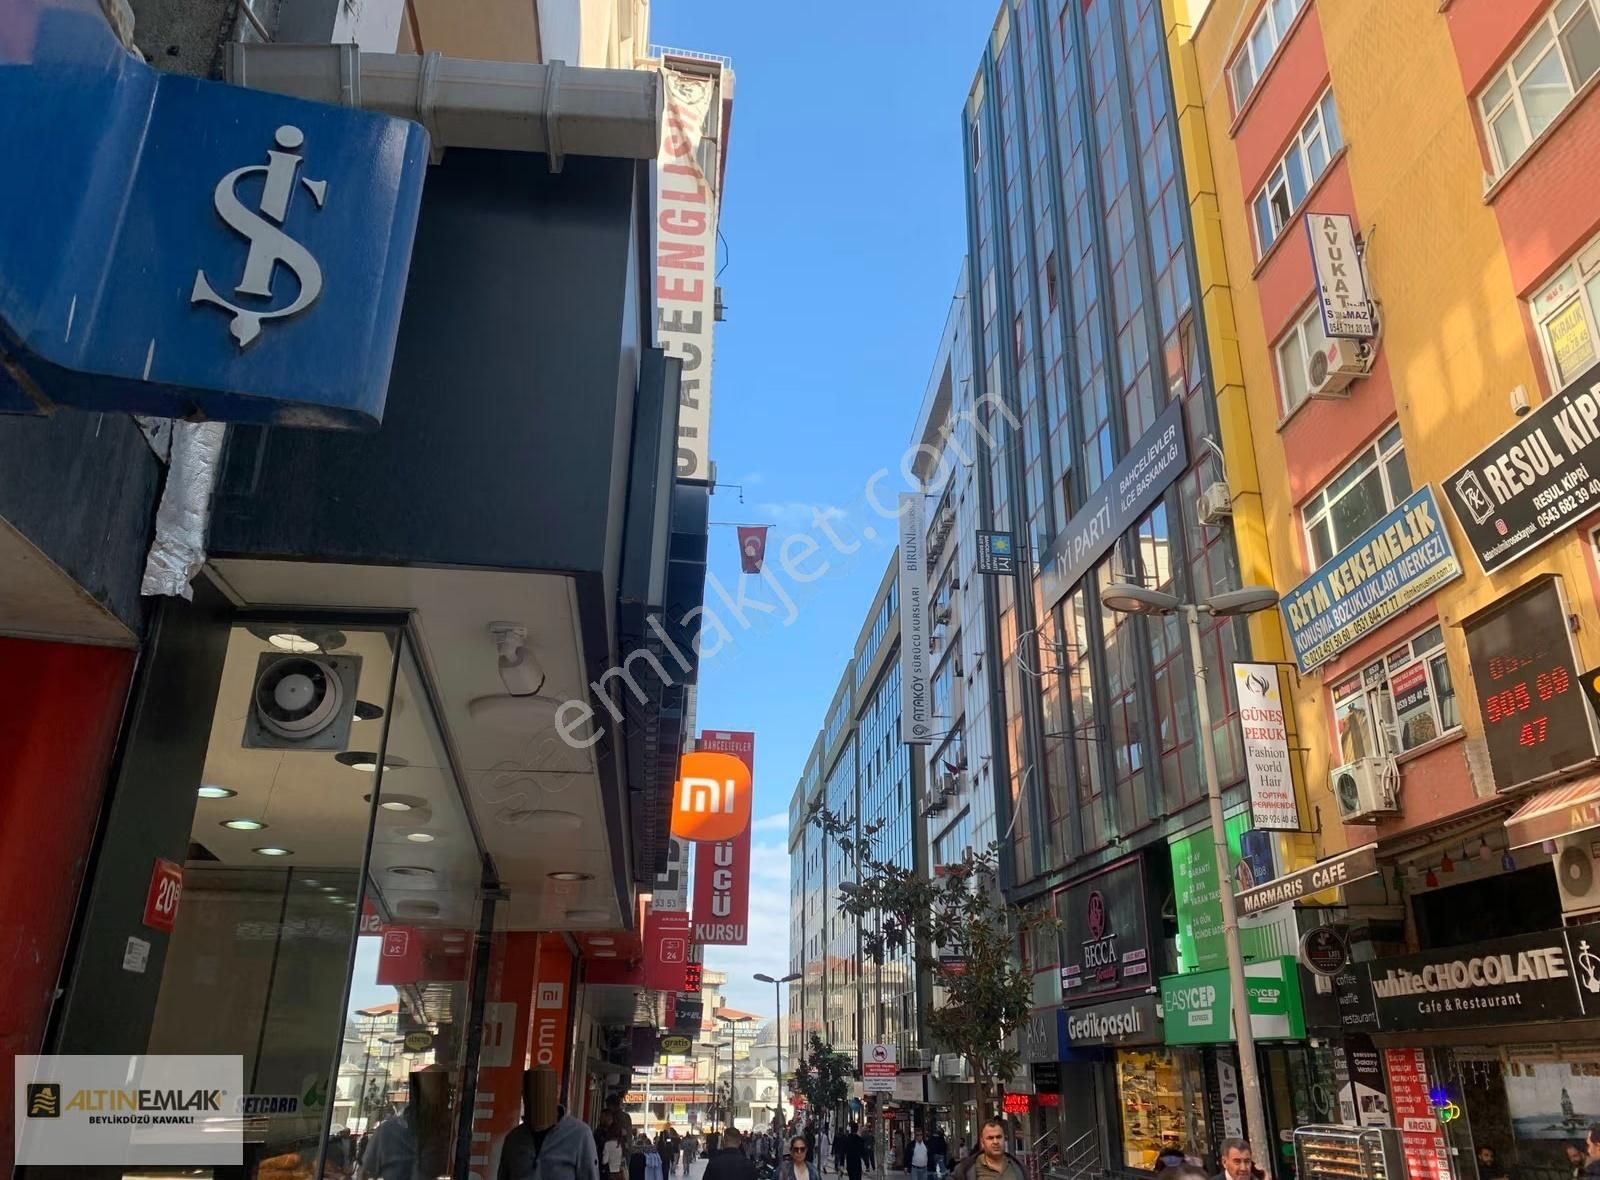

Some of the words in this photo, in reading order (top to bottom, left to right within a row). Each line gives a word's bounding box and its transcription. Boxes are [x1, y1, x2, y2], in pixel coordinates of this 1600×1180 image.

[1323, 216, 1349, 309] AVUKAT
[1119, 423, 1176, 495] BAHÇELİEVLER
[1483, 427, 1565, 505] RESUL
[1120, 489, 1136, 513] İLÇE
[1136, 443, 1178, 497] BAŞKANLIĞI
[1532, 484, 1564, 511] RESUL
[1561, 462, 1590, 492] KİPRİ
[1537, 506, 1560, 528] 0543
[1558, 495, 1578, 515] 682
[1575, 487, 1590, 504] 39
[1589, 478, 1600, 495] 40
[904, 533, 918, 571] BİRUNİ
[1056, 542, 1073, 582] İYİ
[1074, 496, 1111, 563] PARTİ
[999, 557, 1011, 572] İYİ
[1287, 580, 1332, 632] RİTM
[1327, 500, 1436, 602] KEKEMELİK
[1295, 616, 1335, 654] KONUŞMA
[1332, 566, 1399, 628] BOZUKLUKLARI
[1400, 531, 1446, 582] MERKEZİ
[912, 586, 921, 632] KURSLARI
[1309, 647, 1323, 664] 0212
[1323, 640, 1335, 655] 451
[1334, 633, 1343, 648] 50
[1353, 616, 1369, 635] 0531
[1368, 608, 1380, 625] 844
[1380, 601, 1389, 617] 77
[1389, 595, 1399, 610] 77
[911, 634, 922, 673] SÜRÜCÜ
[911, 675, 924, 722] ATAKÖY
[1241, 706, 1284, 725] GÜNEŞ
[1244, 727, 1286, 741] PERUK
[1519, 716, 1548, 746] 47
[1249, 746, 1286, 759] Fashion
[1255, 761, 1283, 773] world
[1257, 791, 1288, 800] TOPTAN
[1260, 774, 1282, 788] Hair
[1254, 814, 1269, 824] 0539
[1268, 815, 1281, 824] 926
[1281, 815, 1289, 824] 40
[1289, 815, 1298, 824] 45
[713, 841, 732, 918] ÜCÜ
[1312, 862, 1347, 888] CAFE
[155, 877, 175, 913] 20
[695, 923, 744, 942] KURSU
[666, 952, 677, 960] 24
[1085, 940, 1117, 968] BECCA
[1336, 974, 1357, 986] coffee
[1373, 947, 1568, 998] whiteCHOCOLATE
[1165, 985, 1216, 1012] EASYCEP
[1339, 992, 1359, 1005] waffle
[1418, 1000, 1443, 1014] Cafe
[1445, 1000, 1453, 1011] &
[1455, 992, 1522, 1011] Restaurant
[1026, 1015, 1048, 1045] AKA
[1068, 1006, 1141, 1042] Gedikpaşalı
[1342, 1012, 1376, 1024] restaurant
[664, 1040, 689, 1048] gratis
[1354, 1058, 1378, 1067] Galaxy
